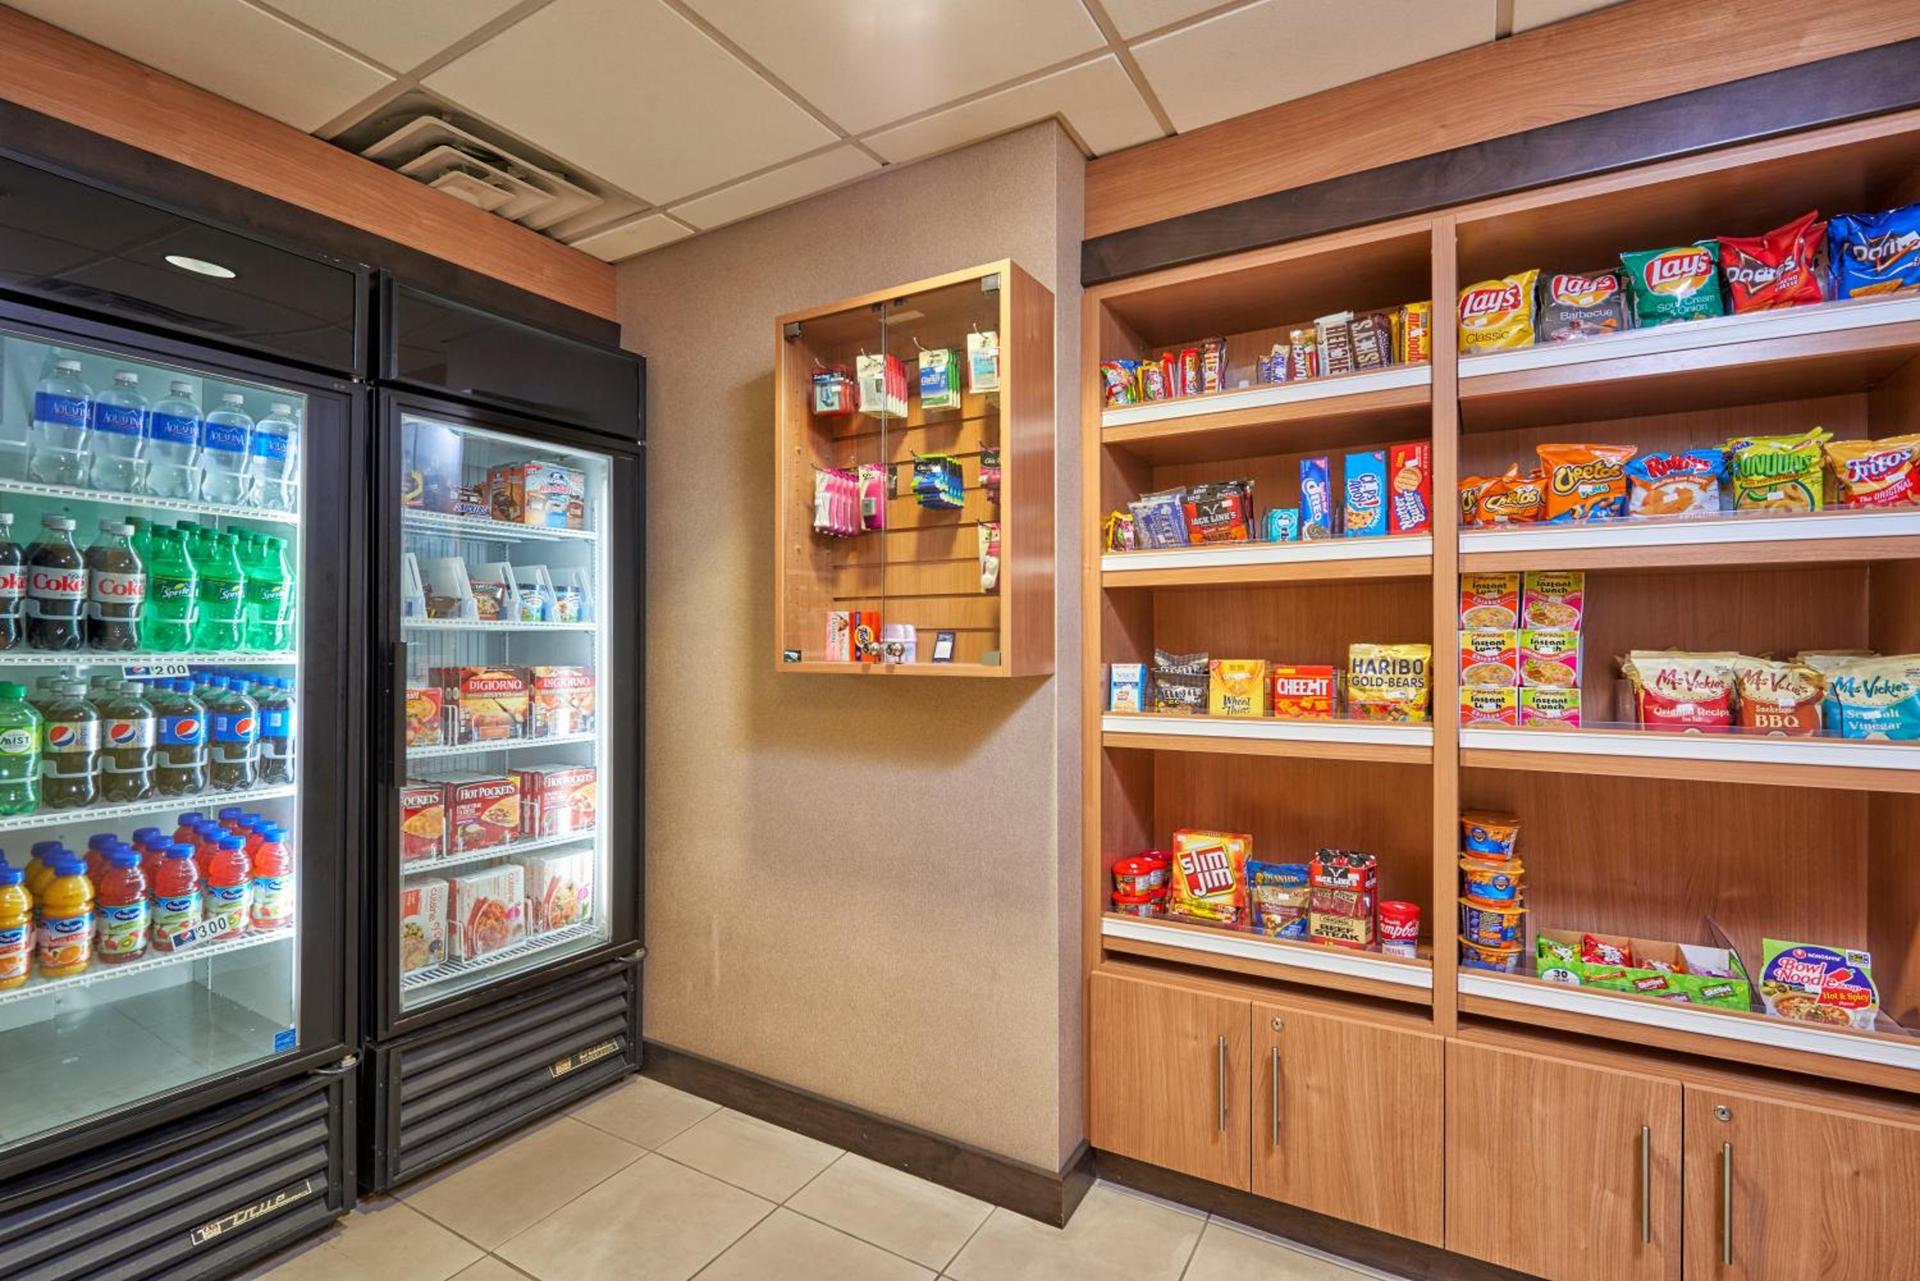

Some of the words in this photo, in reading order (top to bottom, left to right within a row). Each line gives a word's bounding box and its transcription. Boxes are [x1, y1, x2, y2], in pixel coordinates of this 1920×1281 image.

[1652, 255, 1708, 286] Lay's
[1558, 275, 1611, 296] Lay's
[1463, 286, 1518, 320] Lay's
[1678, 304, 1708, 315] Onion
[1560, 309, 1613, 320] Barbecue
[1466, 330, 1510, 345] Classic
[1846, 449, 1913, 482] Fritos
[1554, 462, 1623, 492] Cheetos
[1874, 480, 1912, 500] ORIGINAL
[1304, 480, 1323, 521] OREO
[1485, 490, 1540, 510] Cheetos
[1191, 516, 1209, 525] JACK
[1210, 512, 1237, 524] LINK'S
[33, 573, 84, 592] Coke
[1472, 582, 1507, 590] Instant
[1536, 580, 1571, 588] Instant
[1471, 639, 1506, 647] Instant
[1530, 638, 1566, 646] Instant
[1352, 658, 1424, 675] HARIBO
[469, 679, 523, 691] DIGIORNO
[1351, 677, 1425, 689] GOLD-BEARS
[1222, 695, 1252, 710] Wheat
[1755, 715, 1800, 728] BBQ
[1848, 721, 1902, 731] Vinegar
[460, 788, 478, 800] HOT
[479, 783, 515, 798] POCKETS
[1314, 928, 1359, 942] STEAK
[1779, 957, 1827, 974] Bowl
[1553, 969, 1568, 979] 30
[1774, 967, 1838, 987] Noodle
[1823, 991, 1839, 1000] Hot
[1847, 993, 1870, 1002] Spicy
